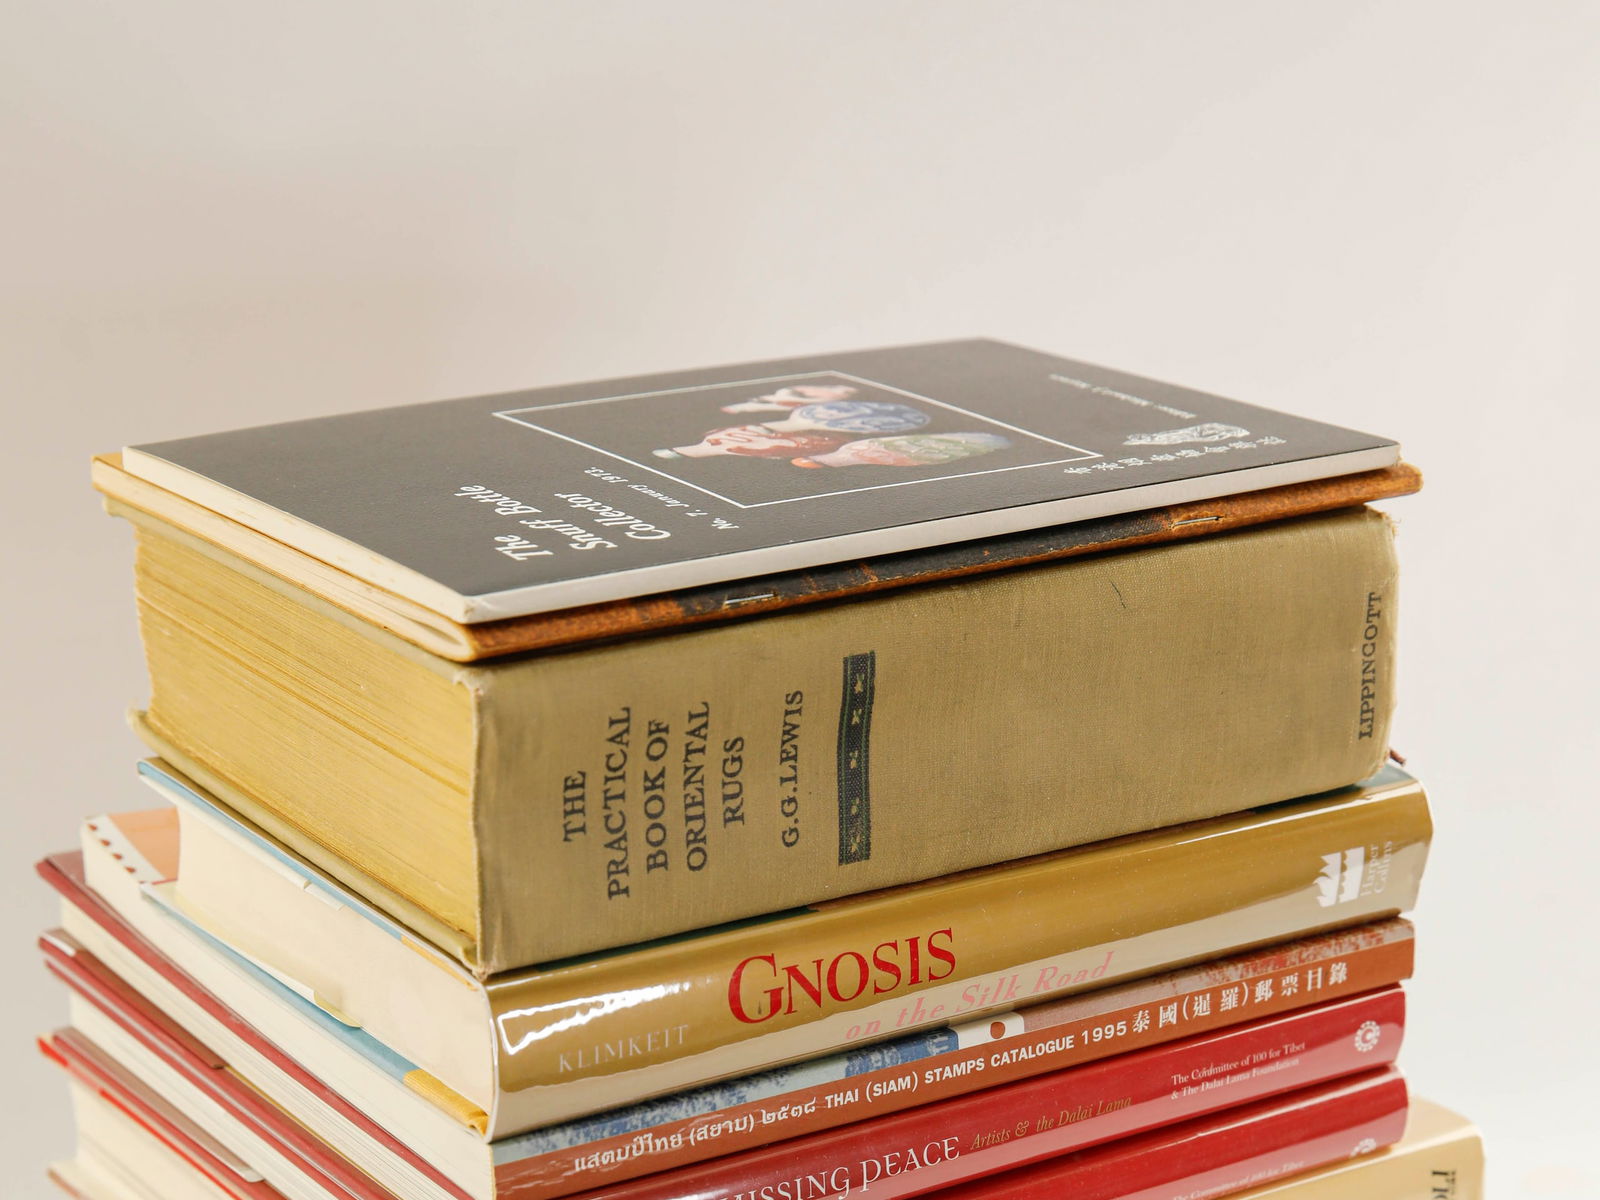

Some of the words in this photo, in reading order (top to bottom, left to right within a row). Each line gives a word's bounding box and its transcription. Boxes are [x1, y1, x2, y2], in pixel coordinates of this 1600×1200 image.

[454, 484, 542, 516] Bottle
[584, 466, 628, 483] 1973.
[627, 483, 690, 508] January
[520, 519, 618, 550] Snuff
[554, 493, 671, 540] Collector
[711, 517, 739, 530] No.
[494, 534, 553, 561] The
[1358, 591, 1383, 741] LIPPINCOTT
[646, 718, 670, 763] OF
[563, 769, 587, 842] THE
[603, 706, 631, 900] PRACTICAL
[682, 701, 710, 872] ORIENTAL
[722, 736, 745, 829] RUGS
[643, 766, 669, 873] BOOK
[1360, 843, 1379, 898] Harper
[1373, 839, 1393, 894] Collins
[727, 927, 957, 1025] GNOSIS
[846, 1019, 882, 1041] on
[895, 997, 946, 1027] the
[952, 973, 1022, 1014] Silk
[1029, 950, 1115, 995] Road
[558, 1023, 690, 1074] KLIMKEIT
[824, 1087, 860, 1110] THAI
[865, 1071, 919, 1103] (SIAM)
[923, 1056, 986, 1084] STAMPS
[989, 1034, 1075, 1069] CATALOGUE
[1081, 1020, 1128, 1046] 1995
[1171, 1073, 1190, 1086] The
[1191, 1060, 1240, 1081] Committee
[1240, 1055, 1251, 1067] of
[1252, 1051, 1268, 1065] 100
[1267, 1046, 1282, 1060] for
[1281, 1041, 1306, 1058] Tibet
[1181, 1083, 1199, 1097] The
[1200, 1077, 1226, 1093] Dalai
[1226, 1070, 1251, 1086] Lama
[1251, 1057, 1300, 1079] Foundation
[760, 1096, 817, 1125] ๒๕๓๘
[969, 1128, 1012, 1151] Artists
[1014, 1119, 1031, 1136] &
[1035, 1114, 1055, 1133] the
[1057, 1105, 1094, 1127] Dalai
[1095, 1094, 1133, 1116] Lama
[859, 1135, 961, 1193] PEACE
